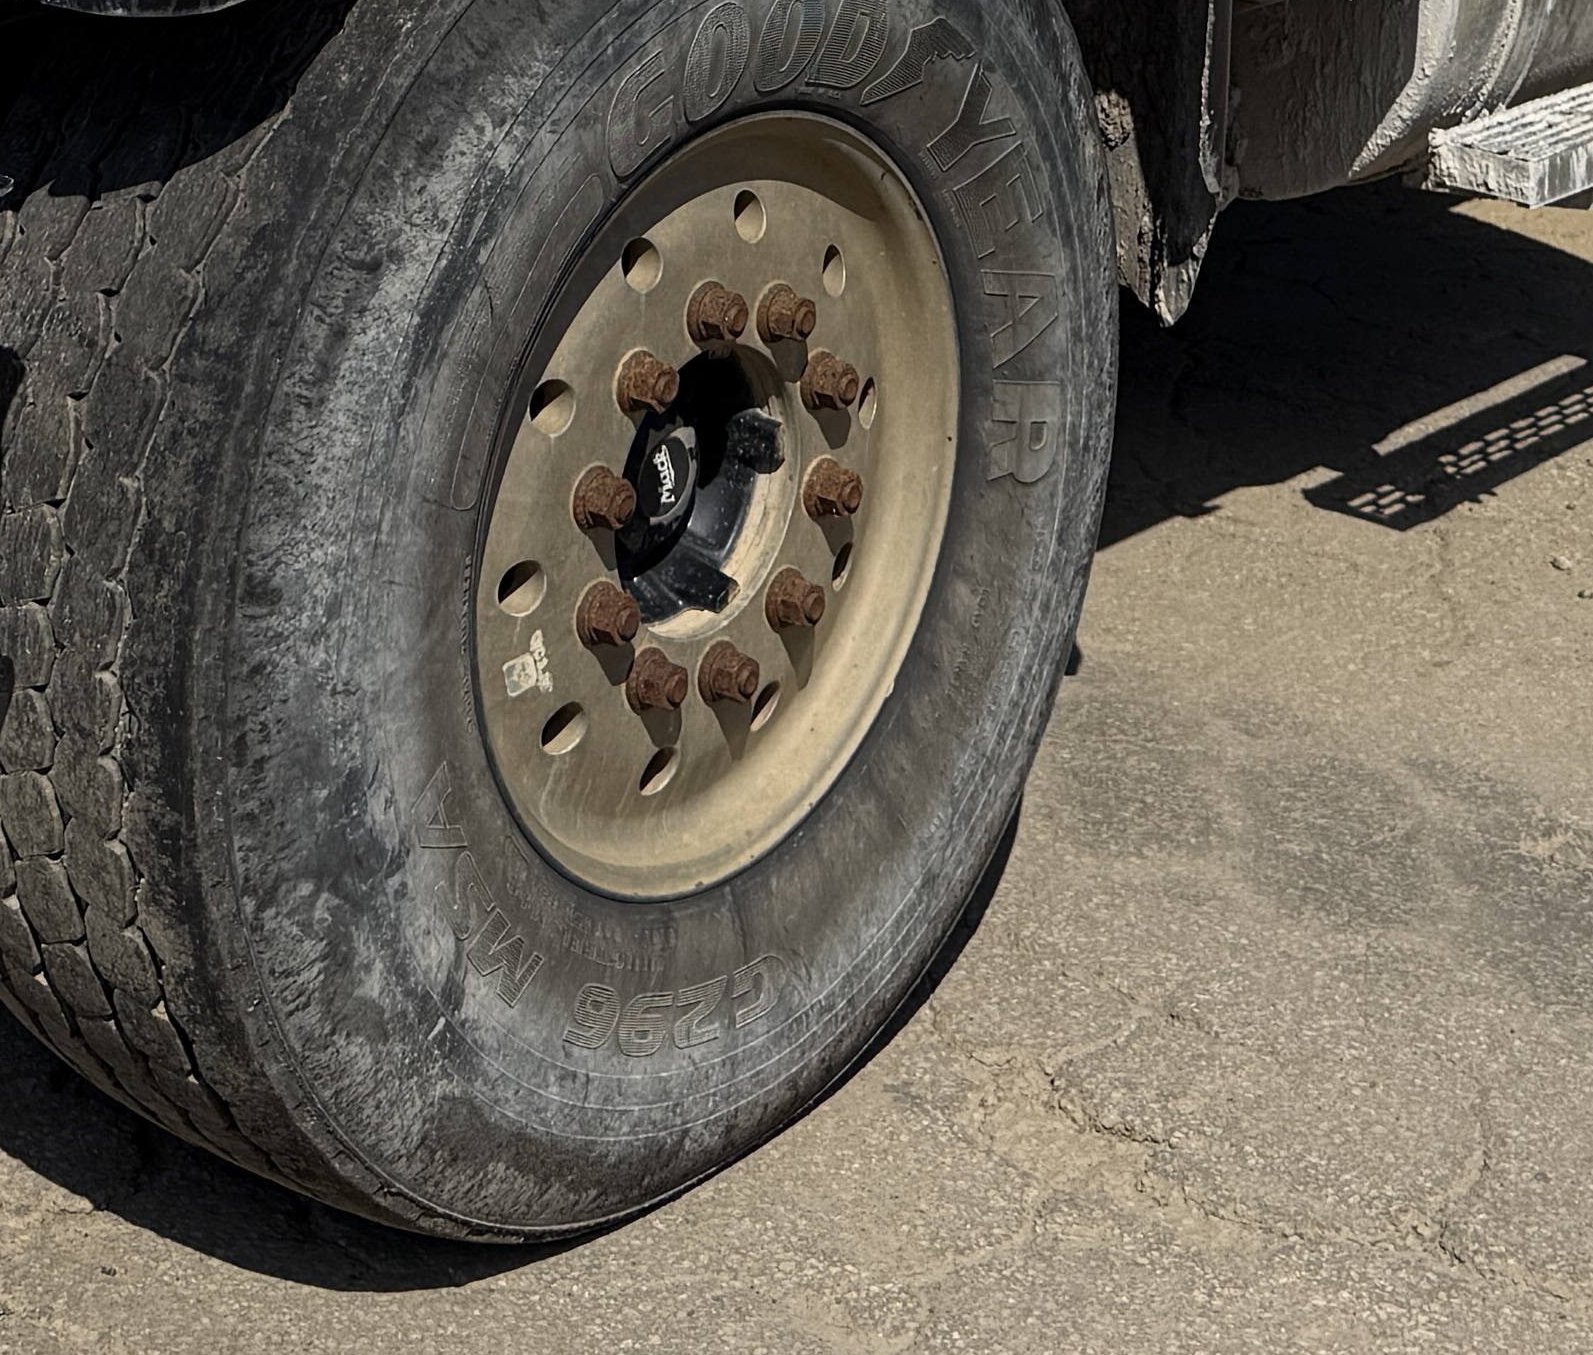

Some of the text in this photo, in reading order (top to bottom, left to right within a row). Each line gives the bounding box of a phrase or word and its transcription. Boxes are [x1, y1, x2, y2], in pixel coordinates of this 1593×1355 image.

[653, 445, 675, 503] Mack
[411, 762, 785, 1057] G296 MSA
